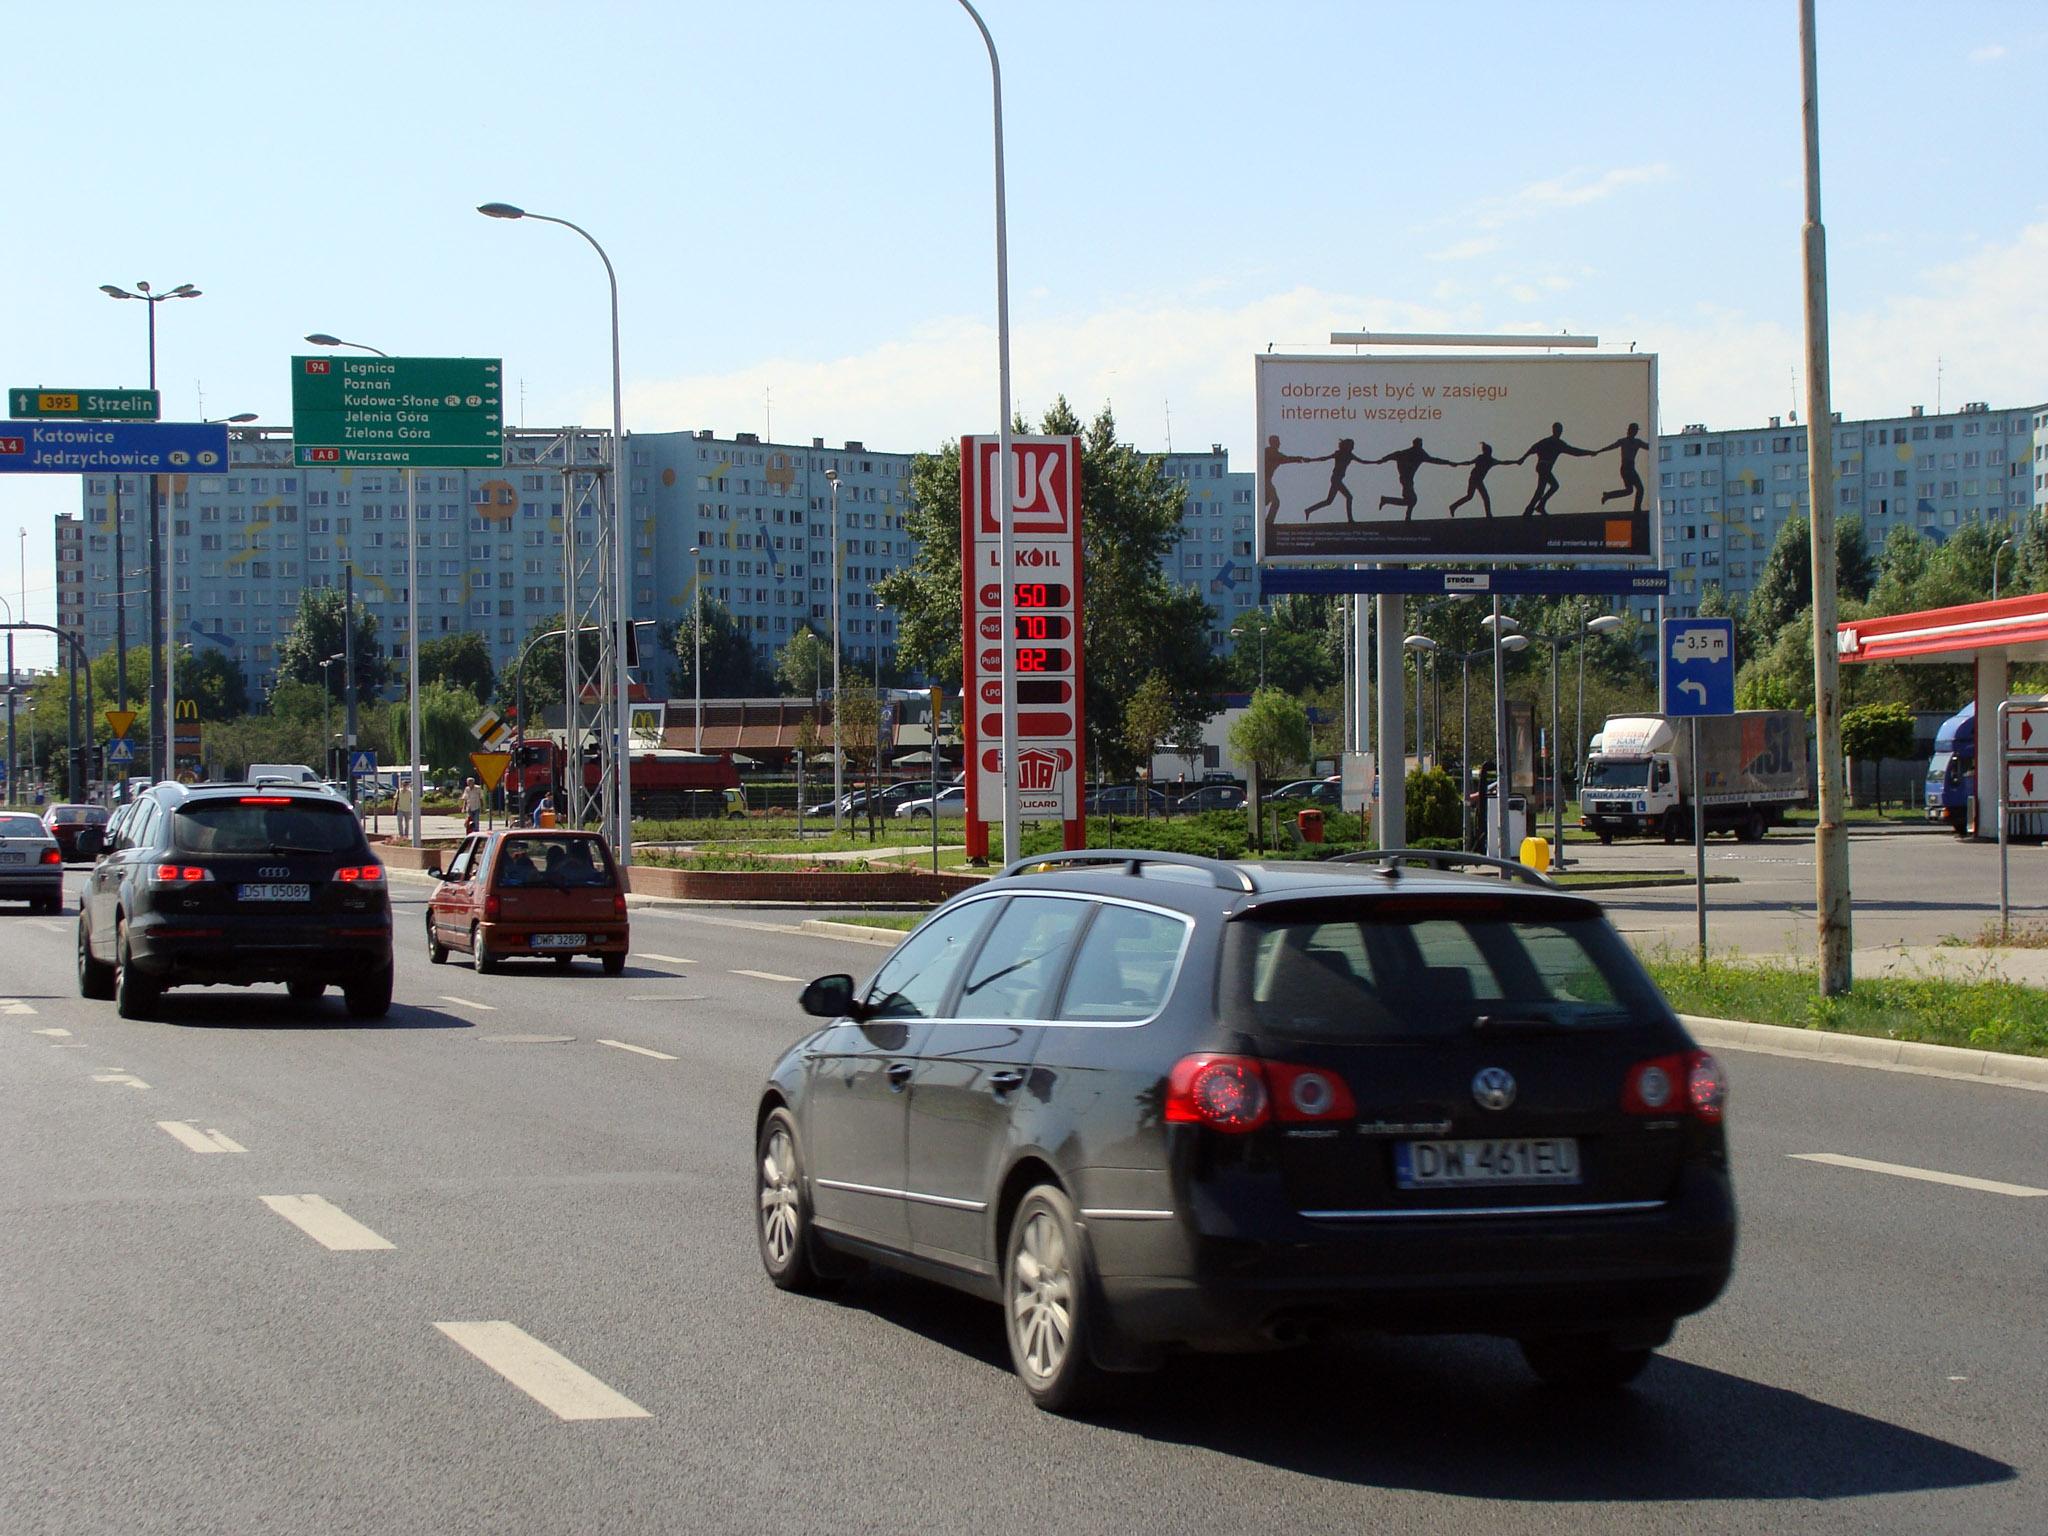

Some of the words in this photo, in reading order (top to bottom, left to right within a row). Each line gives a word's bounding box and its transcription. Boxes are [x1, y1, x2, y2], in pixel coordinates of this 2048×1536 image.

[311, 362, 325, 372] 94
[344, 361, 395, 376] Legnica
[344, 377, 391, 390] Poznań
[1281, 382, 1341, 398] dobrze
[1347, 382, 1378, 400] jest
[1385, 382, 1416, 400] być
[1422, 386, 1436, 397] w
[1442, 383, 1508, 401] zasięgu
[46, 397, 71, 408] 395
[88, 396, 153, 412] Strzelin
[345, 411, 392, 423] Jelenia
[396, 410, 429, 423] Góra
[1281, 404, 1357, 420] internetu
[1364, 404, 1442, 423] wszędzie
[33, 428, 115, 443] Katowice
[345, 427, 394, 439] Zielona
[398, 426, 431, 439] Góra
[33, 450, 161, 468] Jędrzychowice
[174, 453, 185, 463] PL
[203, 453, 212, 463] D
[345, 450, 410, 462] Warszawa
[990, 549, 1061, 567] LKOIL
[988, 592, 1000, 600] ON
[1688, 636, 1708, 649] 3,5
[1713, 639, 1724, 648] m
[986, 688, 1001, 697] LPG
[244, 885, 266, 897] DST
[272, 885, 308, 897] 05089
[536, 935, 554, 945] DWR
